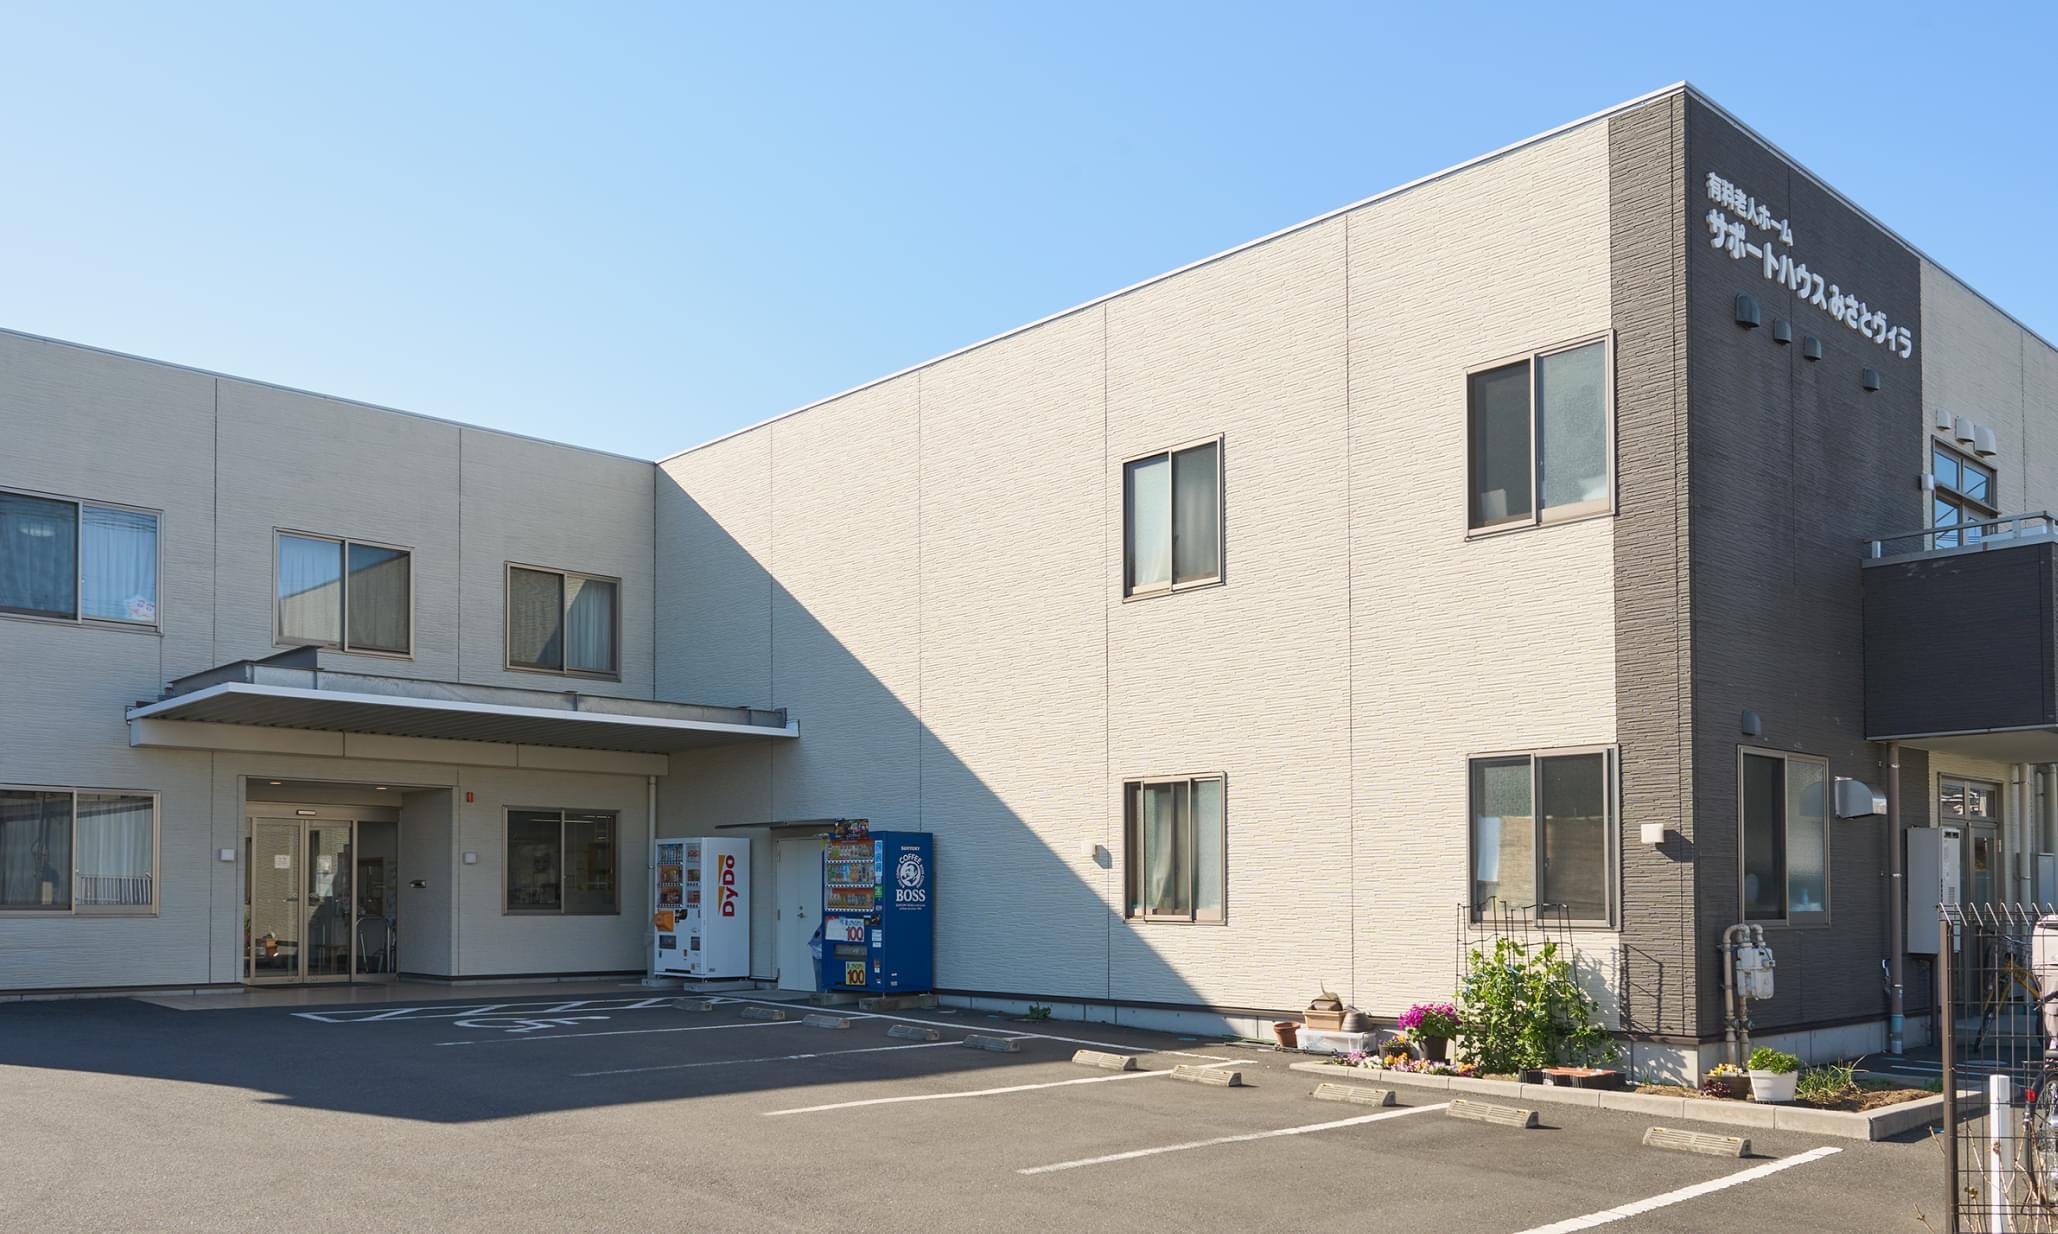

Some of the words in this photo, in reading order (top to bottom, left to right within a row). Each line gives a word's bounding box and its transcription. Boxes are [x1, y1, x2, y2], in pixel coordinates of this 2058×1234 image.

[1706, 172, 1793, 246] 有料老人ホーム
[1706, 208, 1827, 311] サポートハウス
[1828, 284, 1912, 359] みさとヴィラ
[899, 853, 922, 864] COFFEE
[722, 854, 738, 917] DyDo
[896, 889, 926, 902] BOSS
[846, 926, 863, 941] 100
[847, 969, 864, 984] 100
